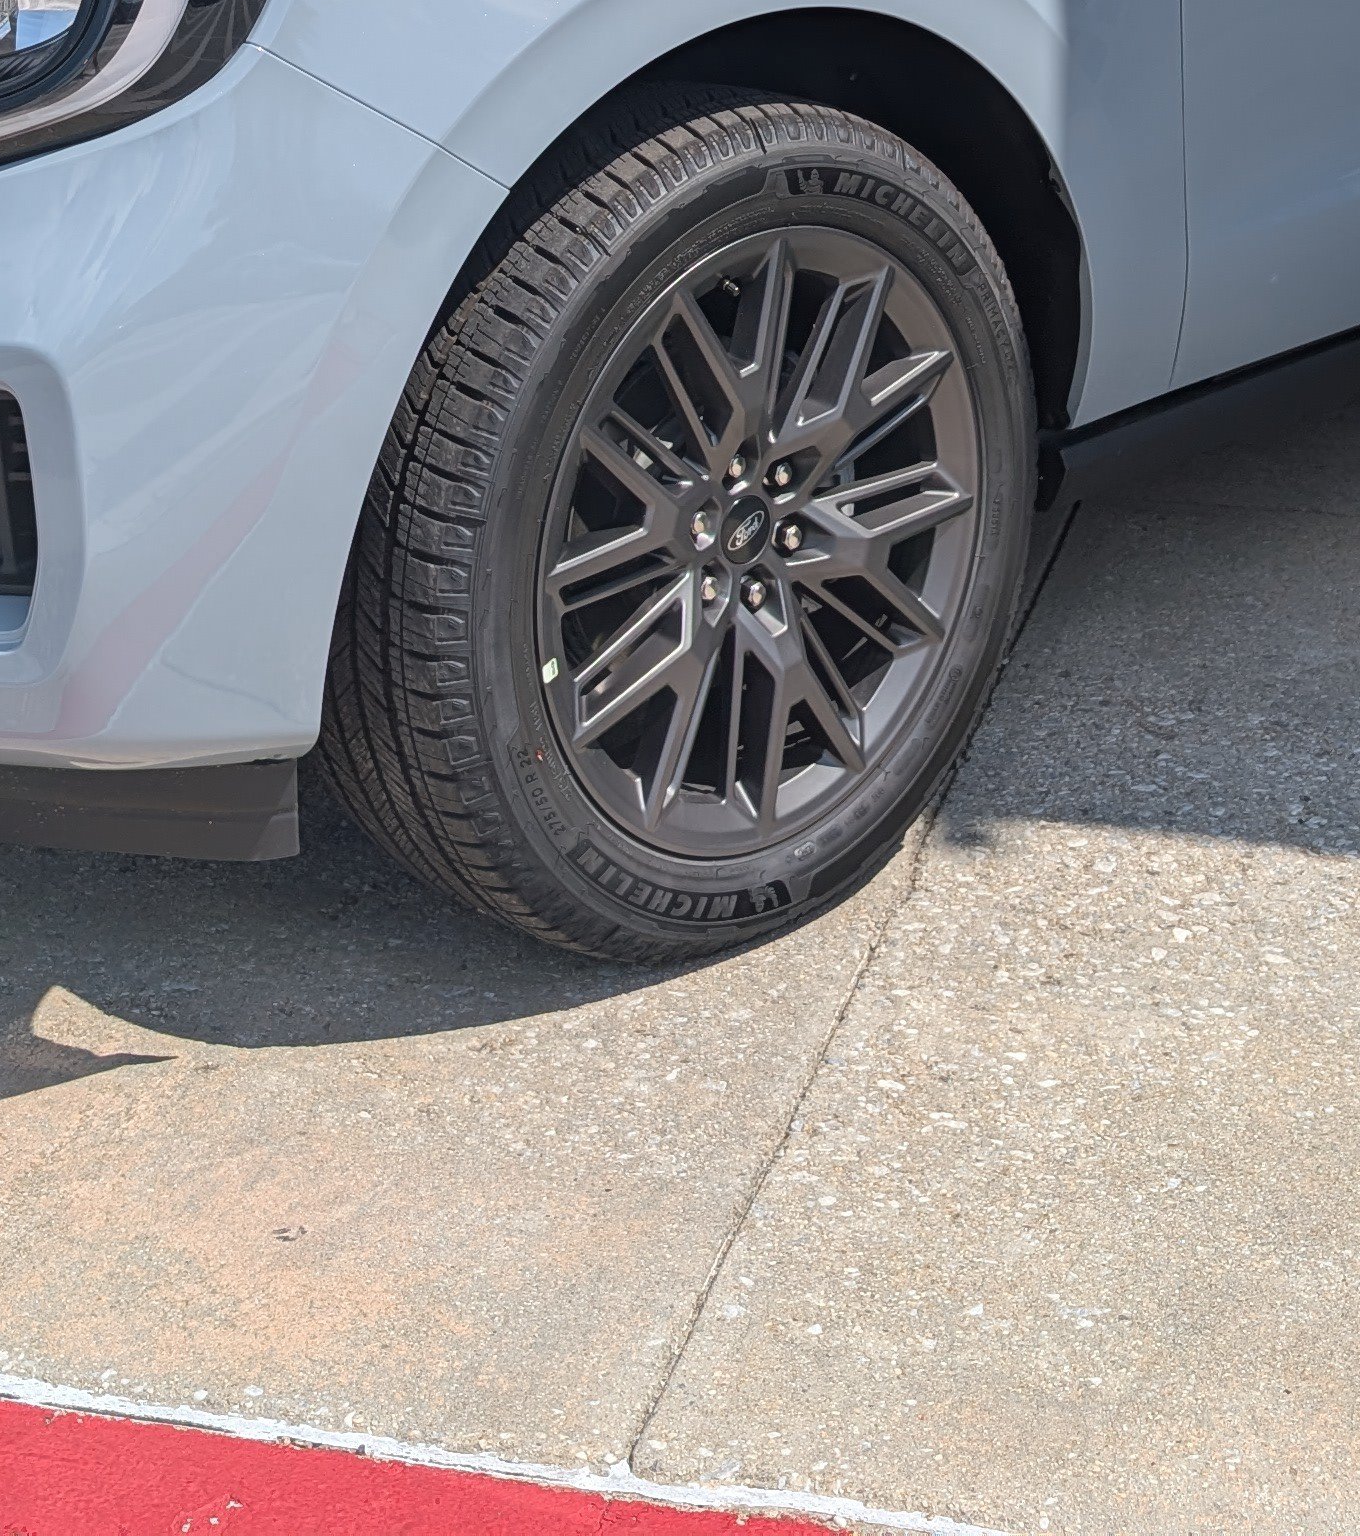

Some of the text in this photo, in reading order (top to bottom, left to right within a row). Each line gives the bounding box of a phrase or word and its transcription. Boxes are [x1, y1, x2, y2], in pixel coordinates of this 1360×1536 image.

[833, 172, 971, 274] MICHELIN
[735, 515, 761, 546] Ford
[517, 745, 533, 770] 22
[531, 786, 567, 837] 275/50
[576, 847, 740, 919] MICHELIN
